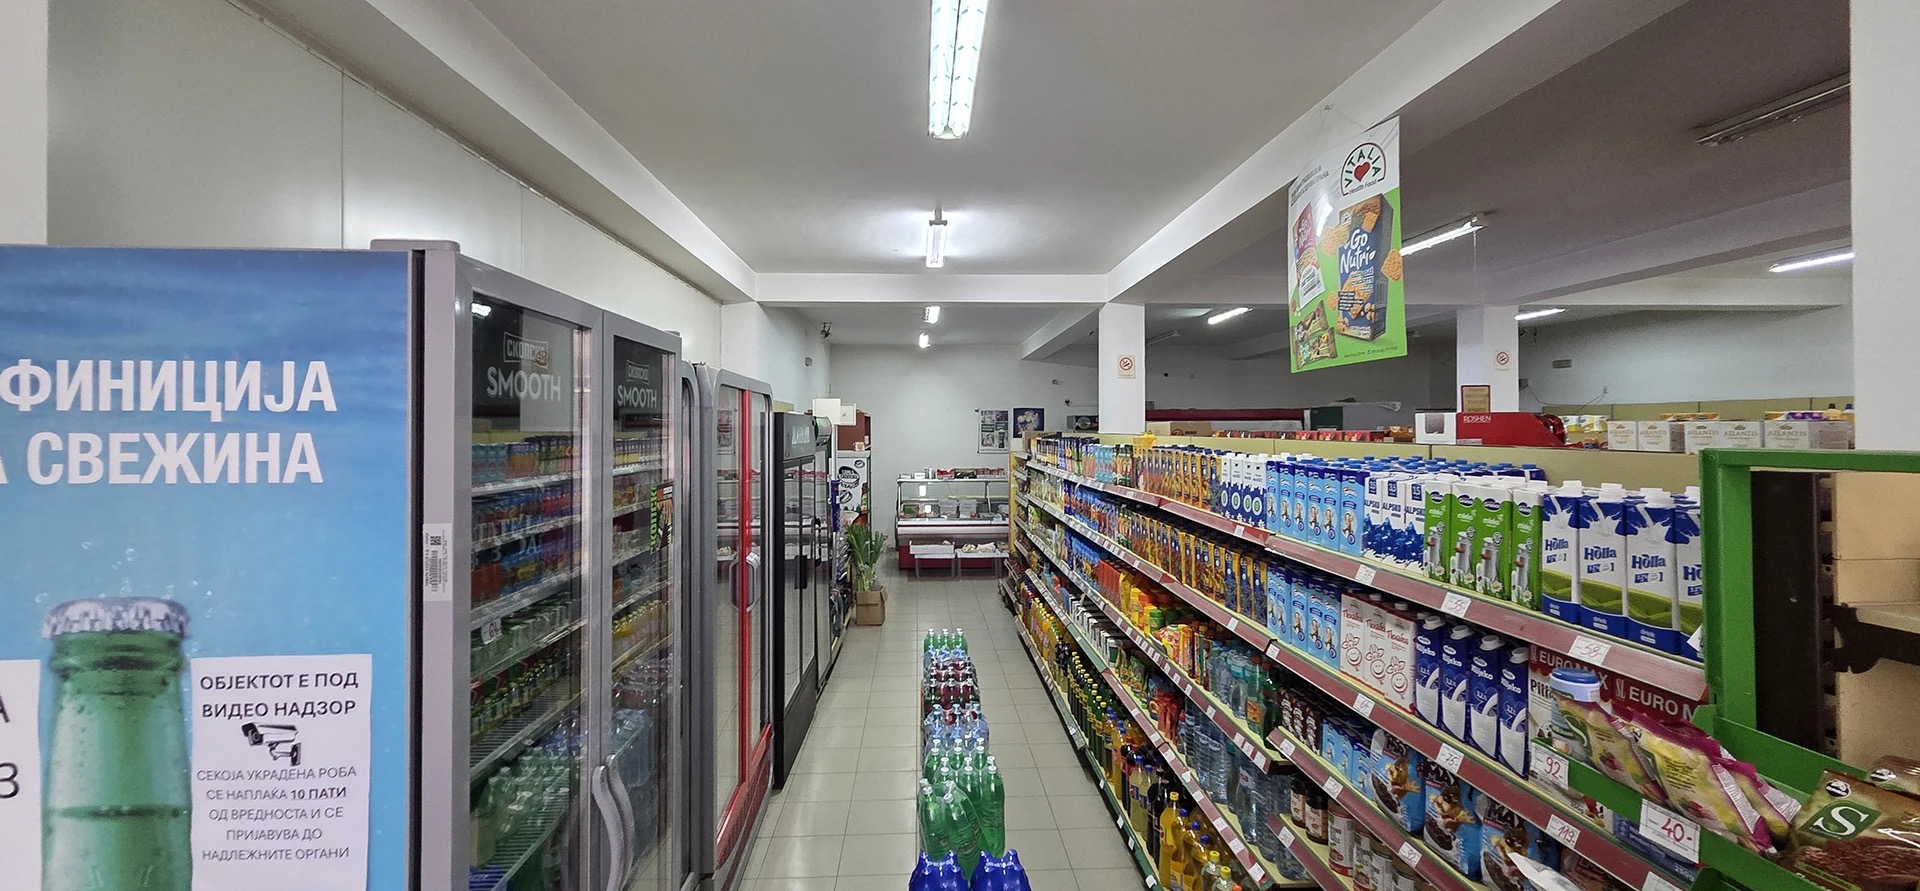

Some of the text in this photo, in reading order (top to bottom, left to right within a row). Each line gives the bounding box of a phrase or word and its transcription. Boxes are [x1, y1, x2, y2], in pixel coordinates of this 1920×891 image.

[1344, 147, 1382, 188] VITALIA
[1350, 228, 1368, 250] Go
[0, 358, 338, 423] ФИНИЦИЈА
[486, 365, 562, 402] SMOOTH
[617, 384, 658, 409] SMOOTH
[1463, 415, 1491, 424] ROSHEN
[26, 431, 324, 485] СВЕЖИНА
[1583, 545, 1617, 561] Holla
[1631, 553, 1667, 570] Holla
[200, 672, 359, 690] ОБЈЕКТОТ Е ПОД
[1628, 685, 1679, 716] EURO
[202, 700, 357, 720] ВИДЕО НАДЗОР
[196, 766, 357, 782] СЕКОЈА УКРАДЕНА РОБА
[206, 786, 347, 801] СЕ НАПЛАЌА 10 ПАТИ
[208, 806, 344, 822] ОД ВРЕДНОСТА И СЕ
[226, 827, 322, 842] ПРИЈАВУВА ДО
[202, 846, 350, 862] НАДЛЕЖНИТЕ ОРГАНИ
